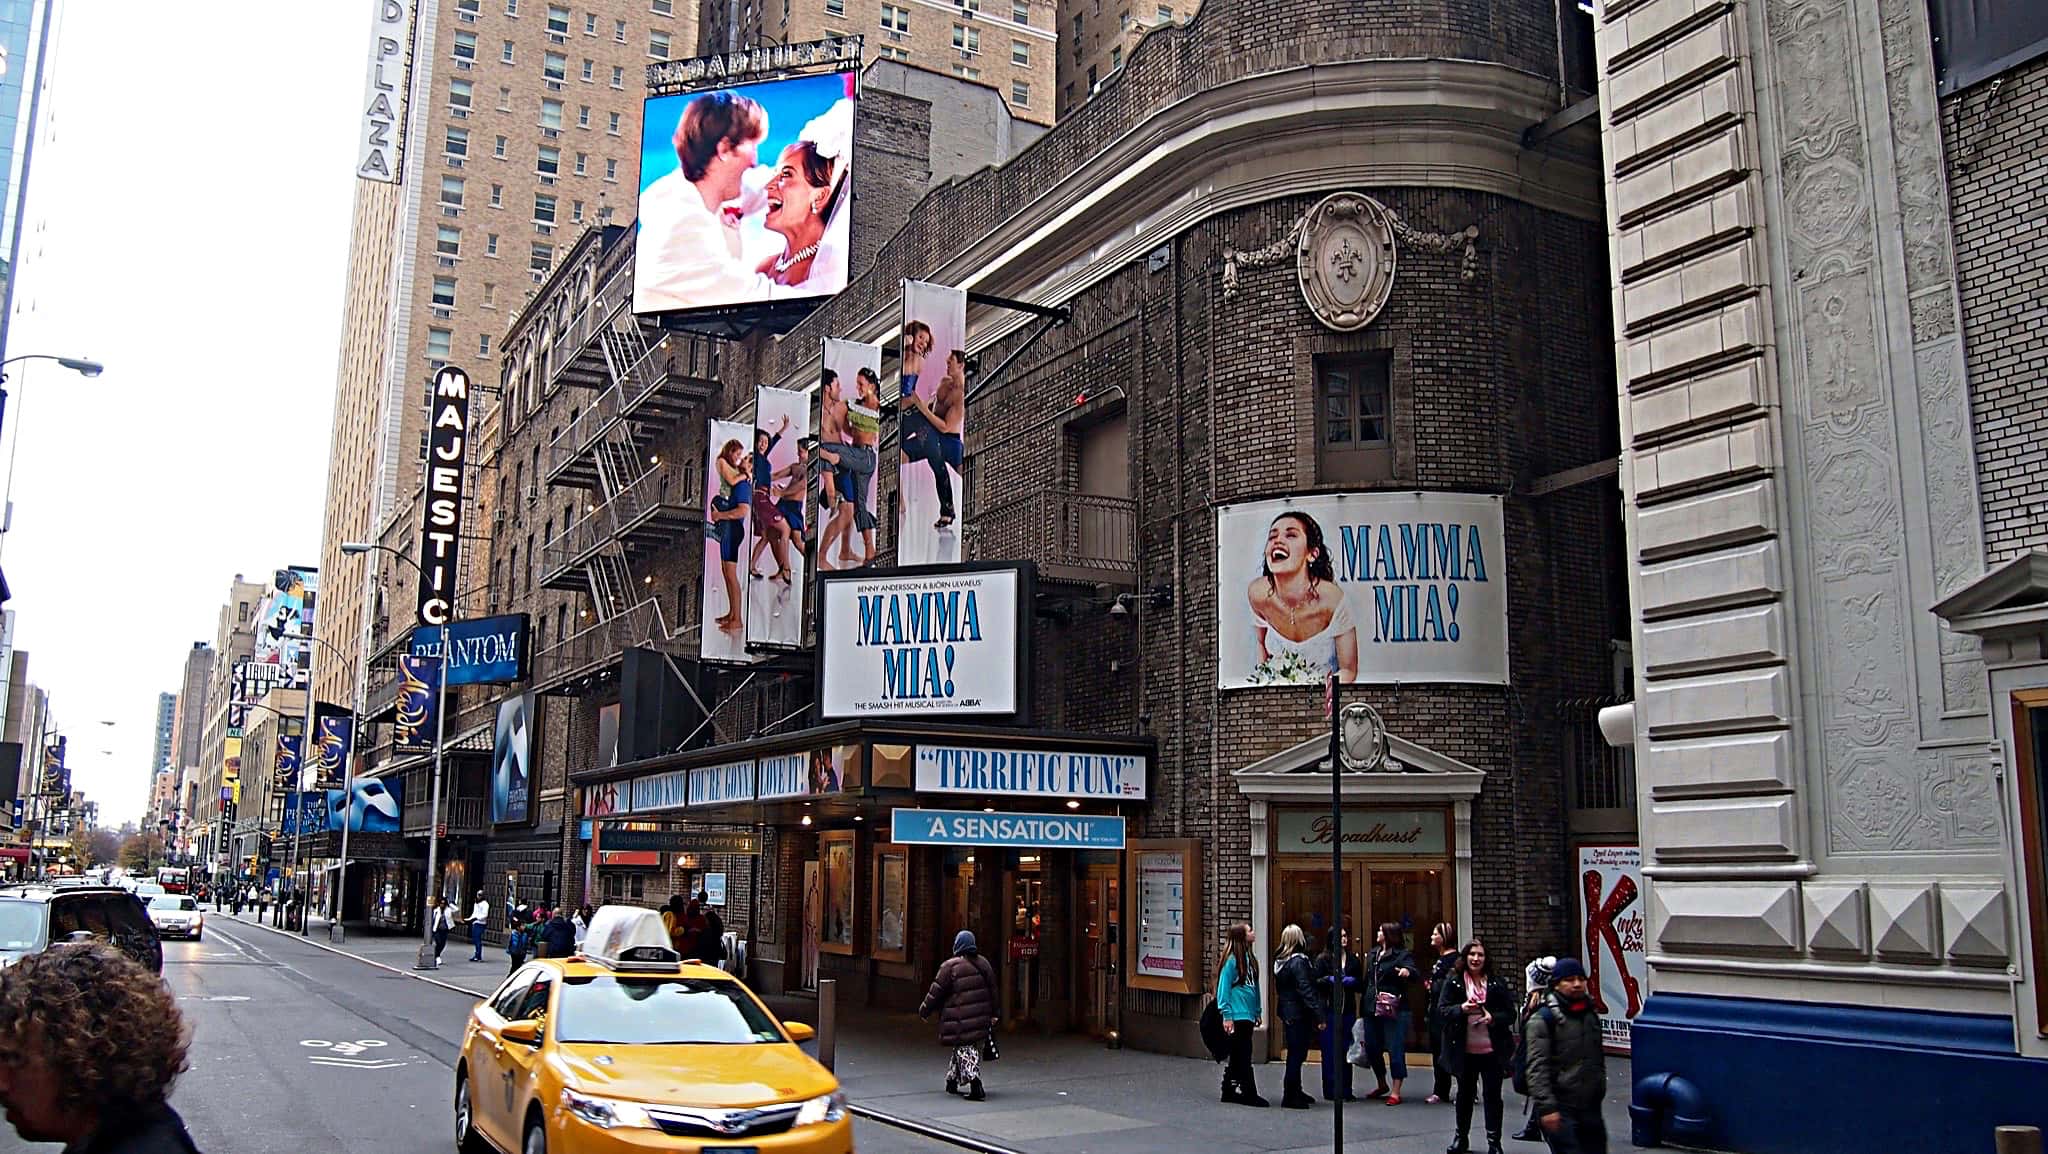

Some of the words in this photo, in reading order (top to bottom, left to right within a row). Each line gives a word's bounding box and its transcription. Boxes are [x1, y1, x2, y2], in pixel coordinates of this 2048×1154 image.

[646, 35, 860, 87] BROADHURST
[361, 36, 399, 176] PLAZA
[422, 373, 467, 626] MAJESTIC
[1339, 522, 1488, 582] MAMMA
[857, 584, 879, 593] BENNY
[1373, 582, 1461, 644] MIA!
[856, 590, 983, 647] MAMMA
[881, 644, 955, 700] MIA!
[855, 702, 867, 711] THE
[868, 701, 893, 710] SMASH
[905, 700, 935, 709] MUSICAL
[760, 758, 785, 797] LOVE
